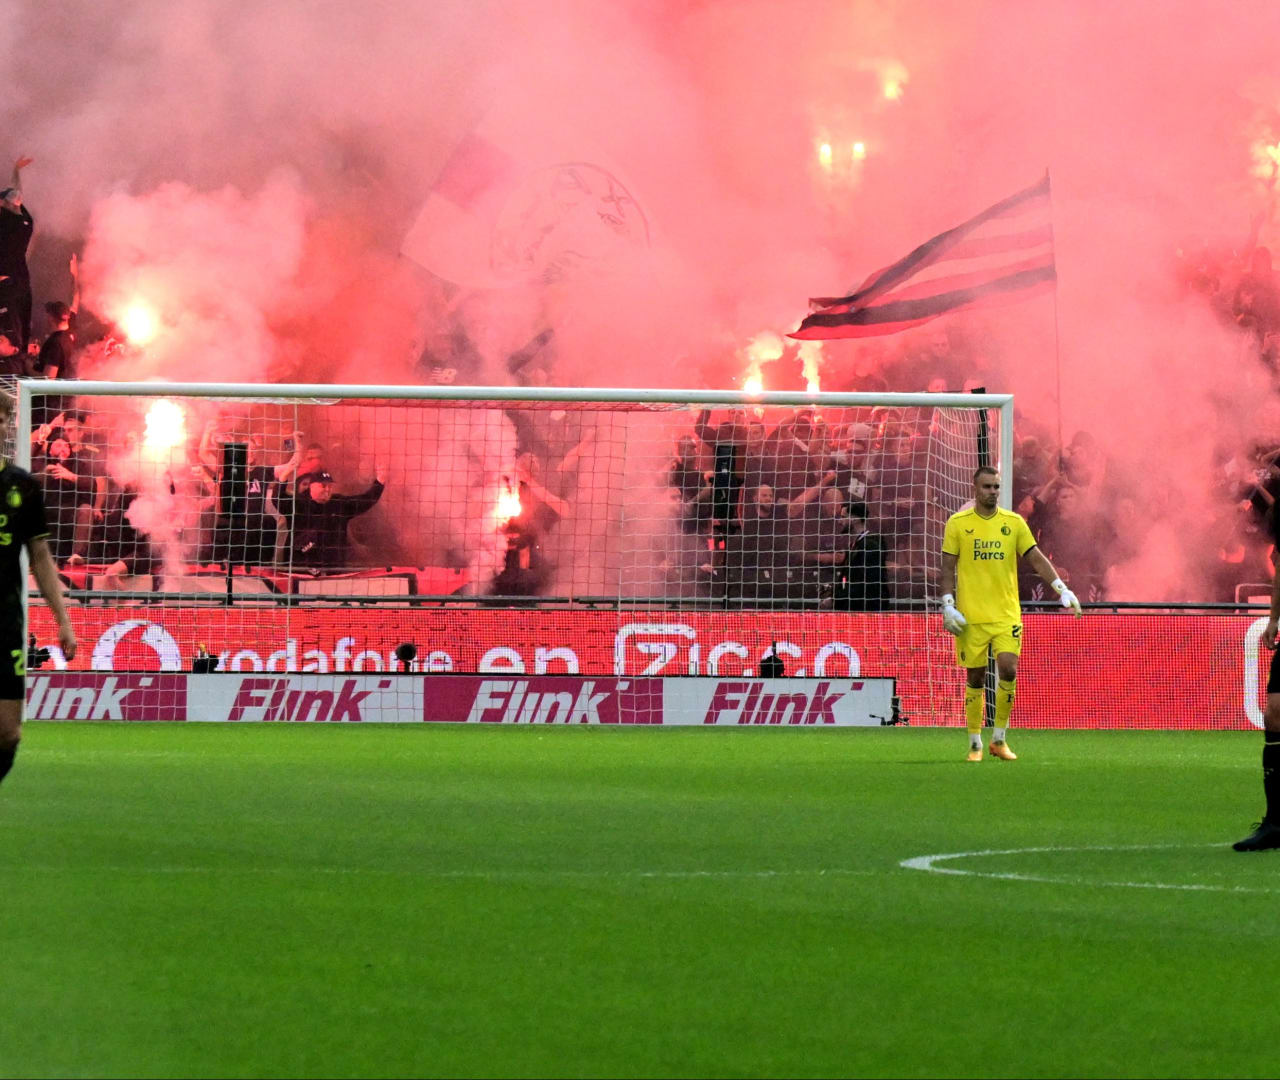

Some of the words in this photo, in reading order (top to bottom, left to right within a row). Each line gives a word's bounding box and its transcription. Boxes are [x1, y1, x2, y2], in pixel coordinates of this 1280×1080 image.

[973, 538, 1001, 550] Euro
[973, 549, 1004, 561] Parcs
[479, 647, 579, 674] en
[25, 677, 153, 720] link
[228, 678, 392, 722] Flink
[466, 680, 630, 724] Flink
[703, 682, 864, 725] Flink
